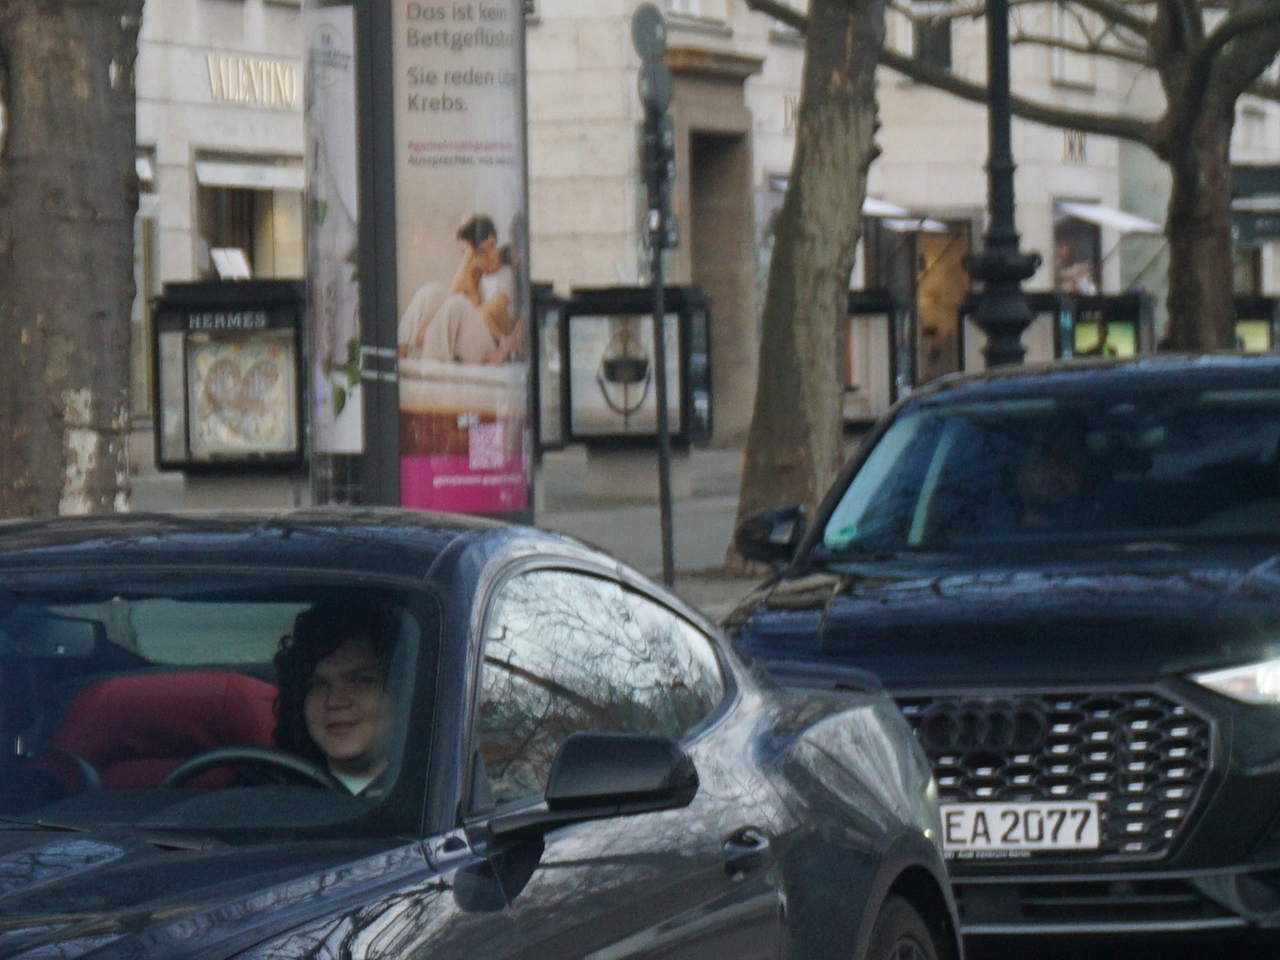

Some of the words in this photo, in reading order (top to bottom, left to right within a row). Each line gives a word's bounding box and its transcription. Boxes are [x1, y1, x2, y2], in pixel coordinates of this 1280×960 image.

[406, 2, 446, 21] Das
[451, 1, 474, 21] ist
[206, 54, 296, 108] VALENTINO
[406, 66, 438, 85] Sie
[443, 66, 495, 85] reden
[407, 91, 469, 112] Krebs.
[944, 809, 992, 845] EA
[1000, 808, 1092, 844] 2077
